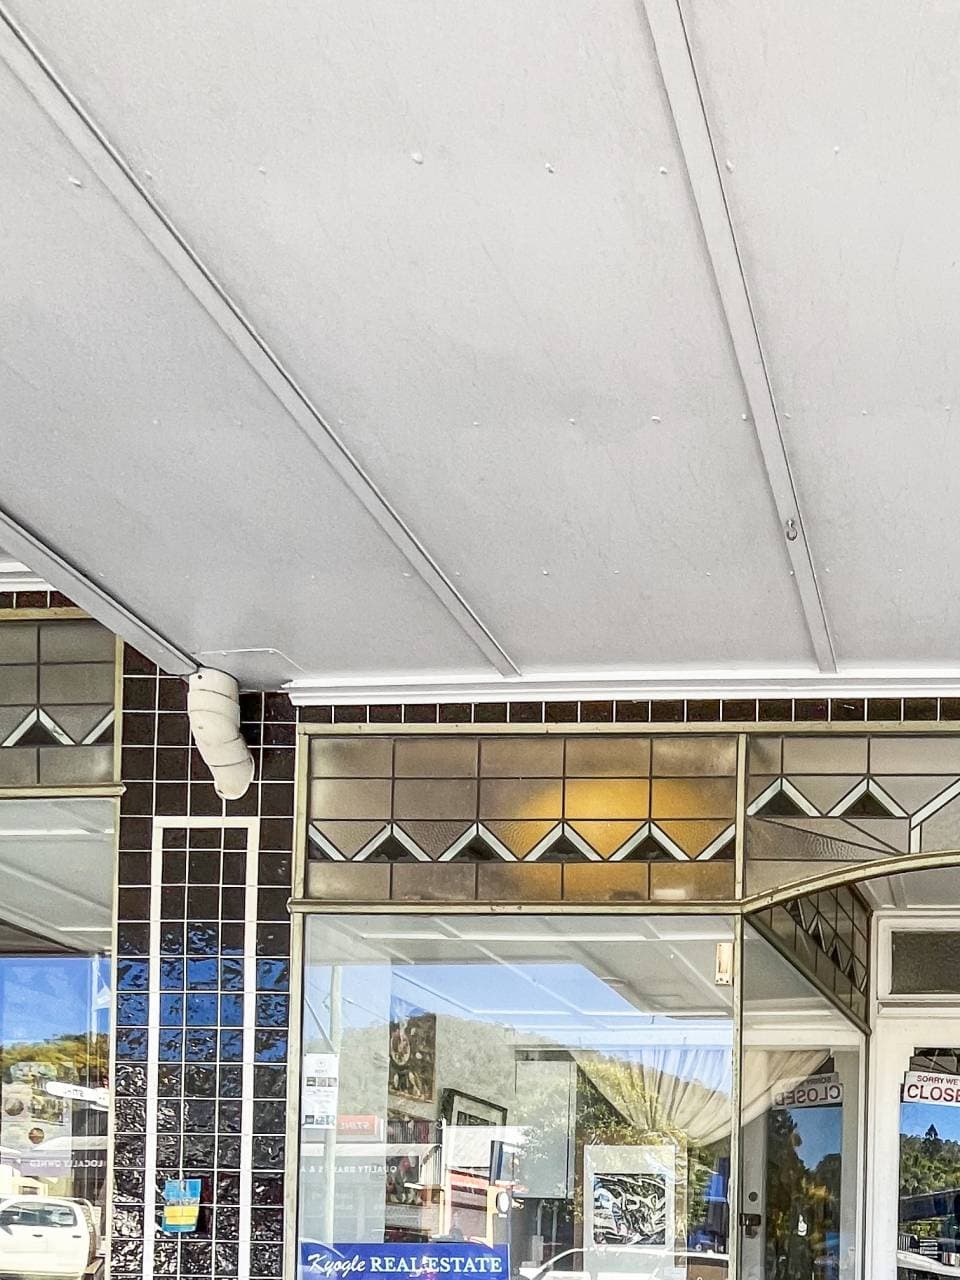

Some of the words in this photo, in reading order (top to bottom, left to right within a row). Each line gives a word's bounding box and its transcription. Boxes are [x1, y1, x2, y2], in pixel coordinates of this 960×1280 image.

[916, 1074, 944, 1084] SORRY
[308, 1253, 366, 1278] Kyogle
[370, 1256, 421, 1273] REAL
[428, 1256, 503, 1273] ESTATE
